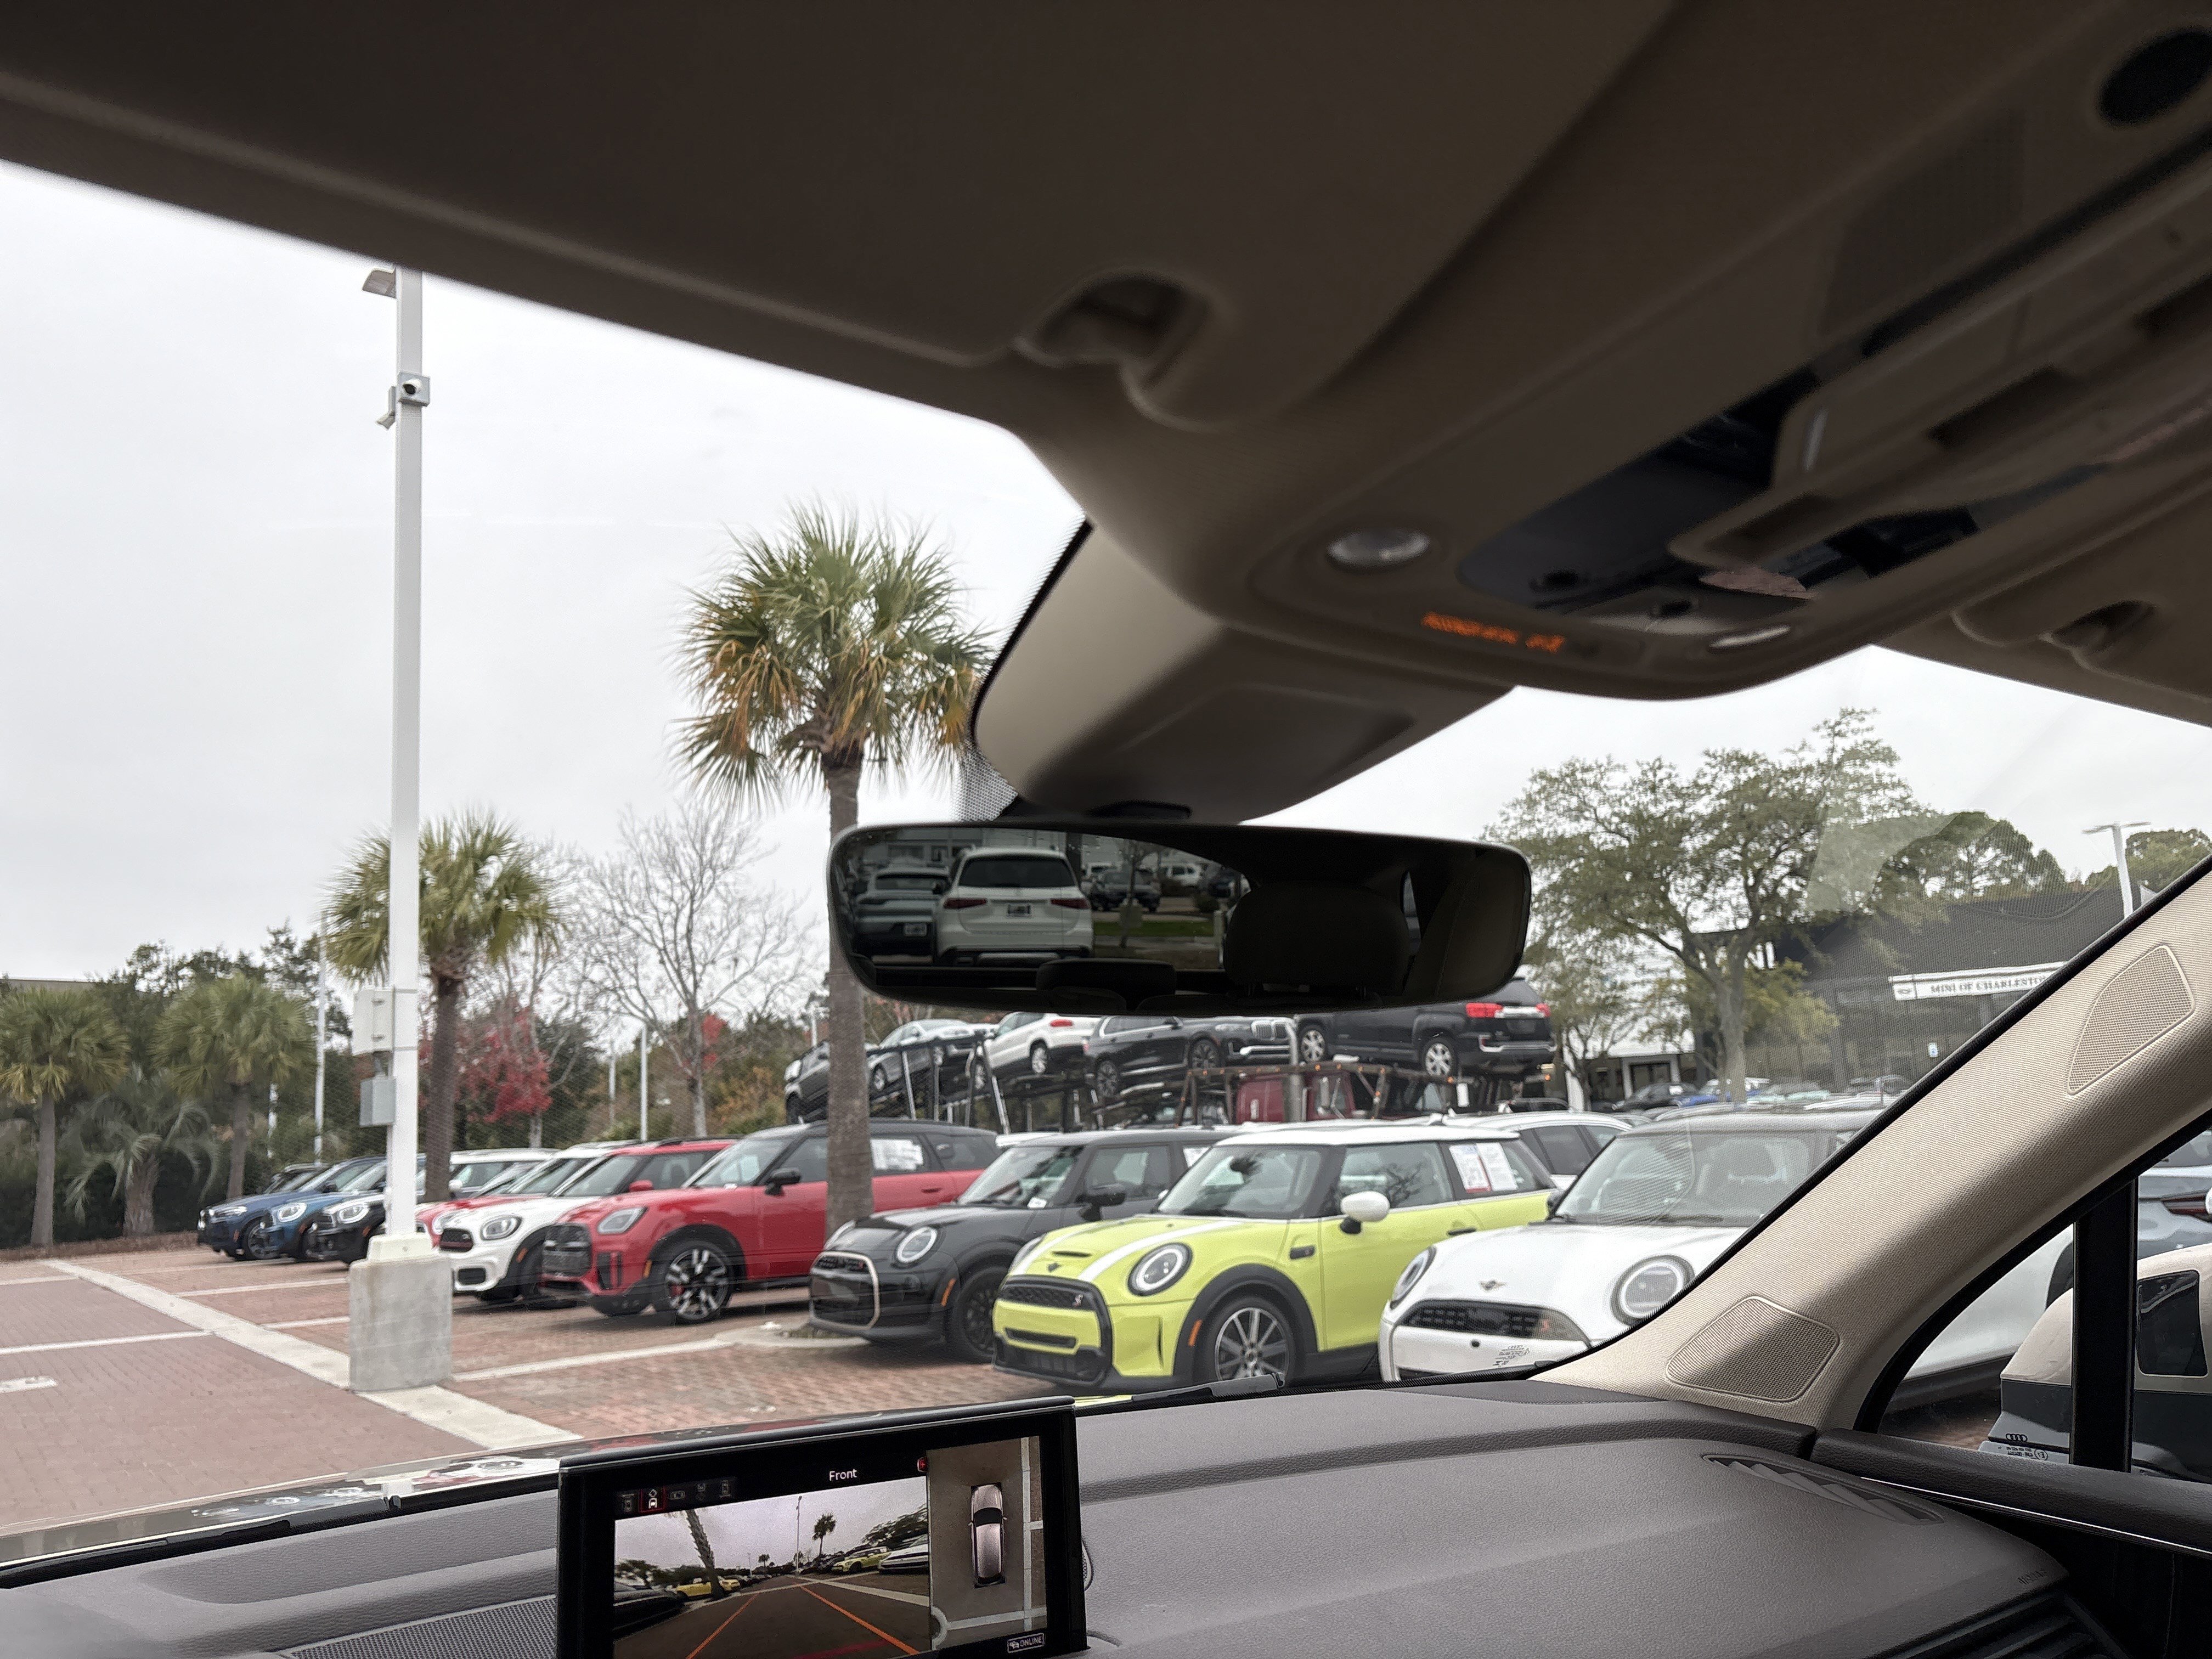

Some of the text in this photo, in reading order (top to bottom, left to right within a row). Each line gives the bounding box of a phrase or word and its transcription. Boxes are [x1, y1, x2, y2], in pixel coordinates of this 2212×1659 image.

[1931, 975, 2046, 993] MINI OF CHARLESTO
[829, 1468, 857, 1481] Front
[1020, 1635, 1042, 1647] ONLINE
